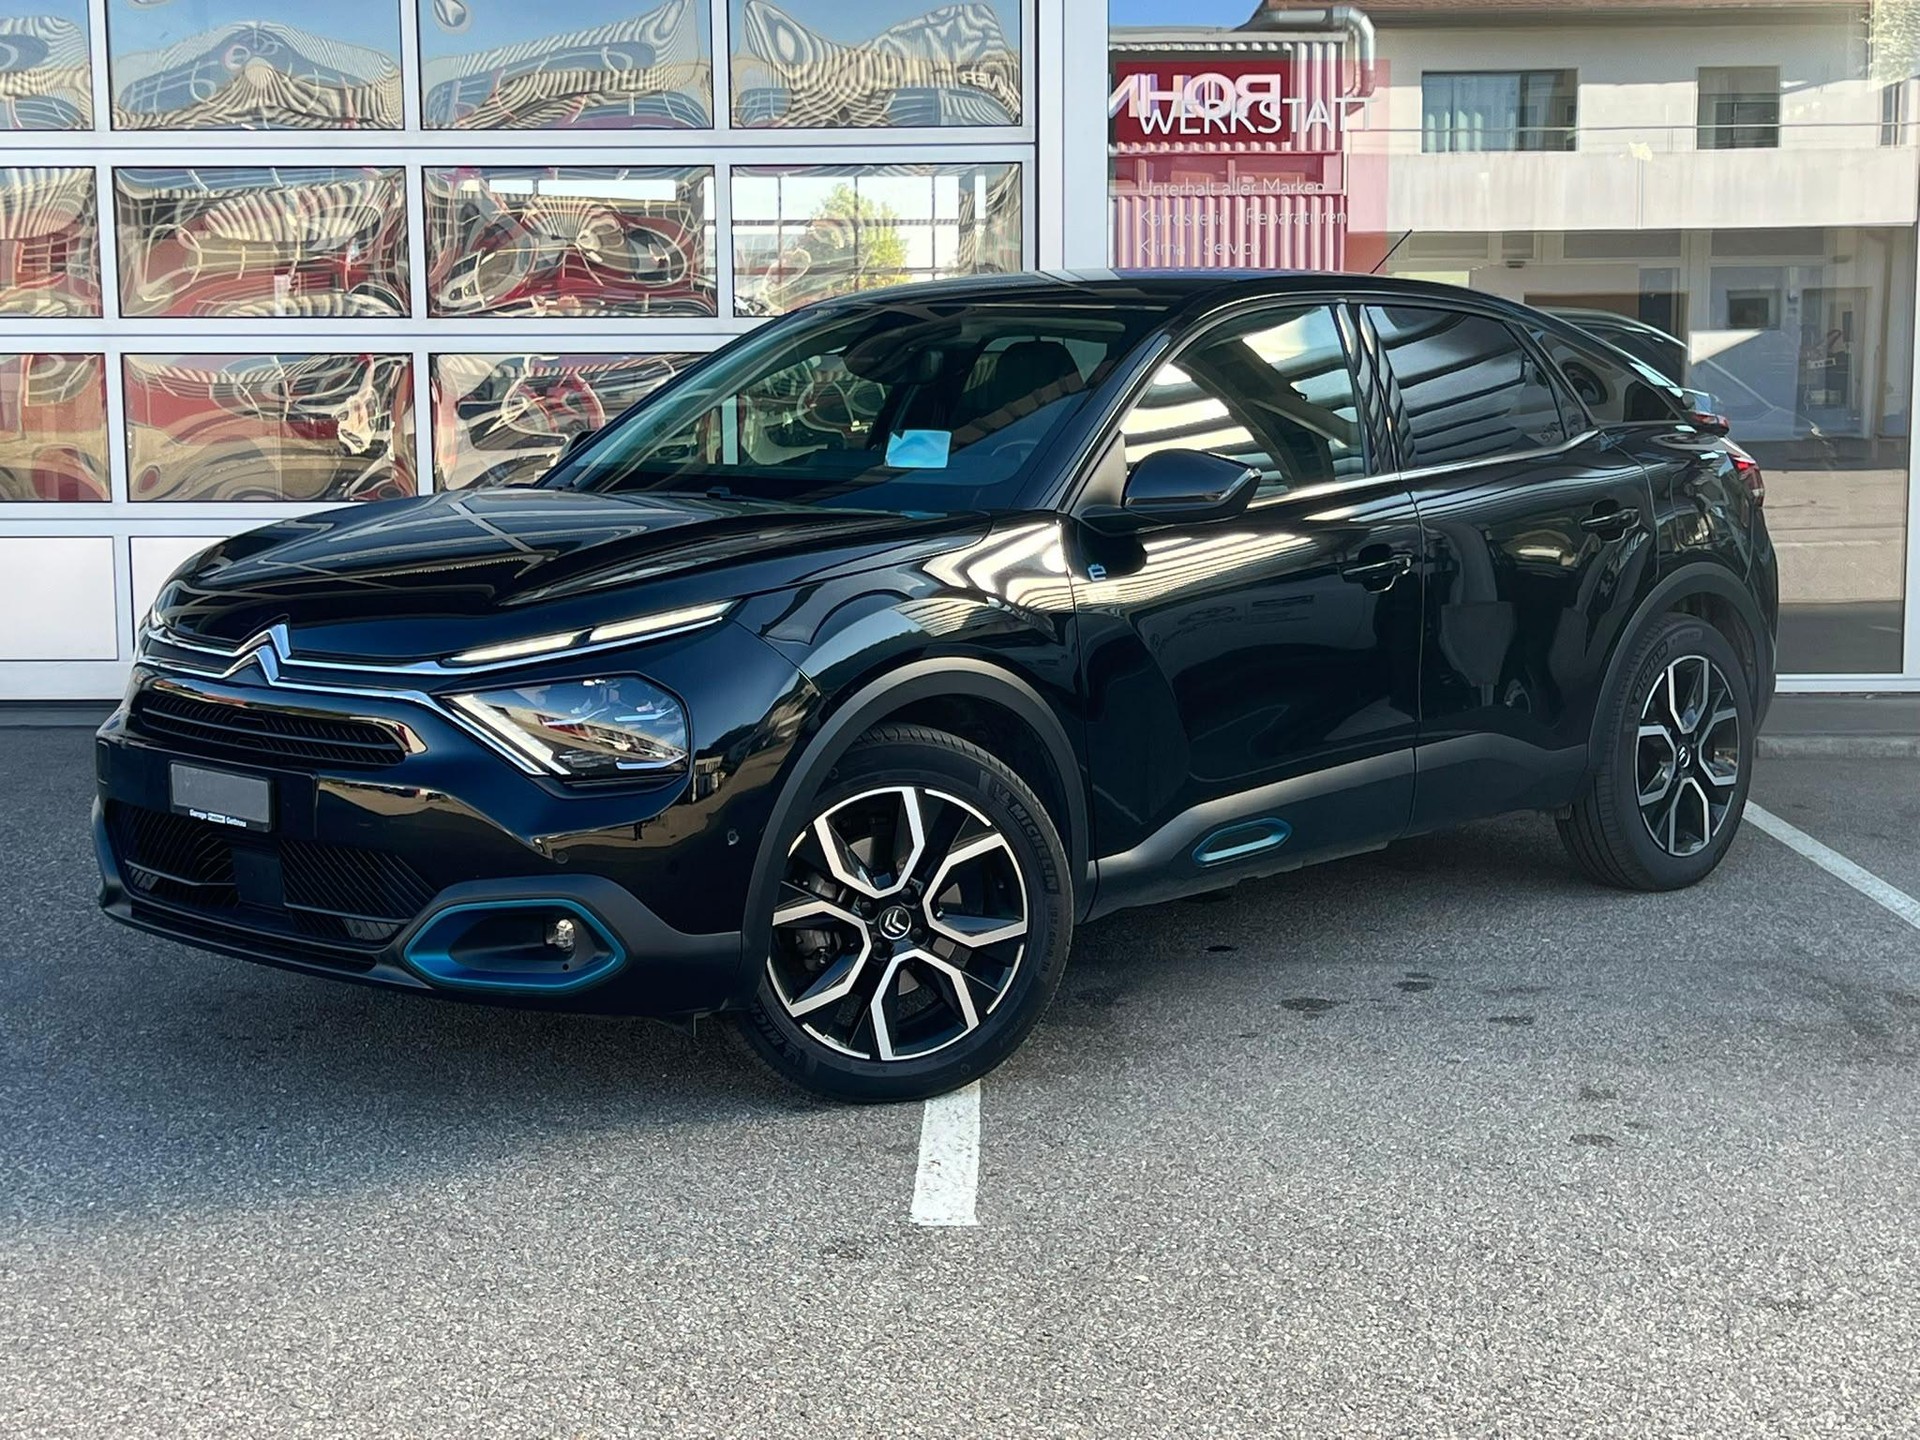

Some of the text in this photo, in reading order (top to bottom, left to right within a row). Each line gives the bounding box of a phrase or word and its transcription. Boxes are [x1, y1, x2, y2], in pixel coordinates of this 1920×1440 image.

[1137, 97, 1377, 134] WERKSTATT
[1138, 176, 1326, 196] Unterhalt aller Marken
[1140, 237, 1262, 256] Kima Sevce
[1010, 805, 1058, 893] MICHELIN
